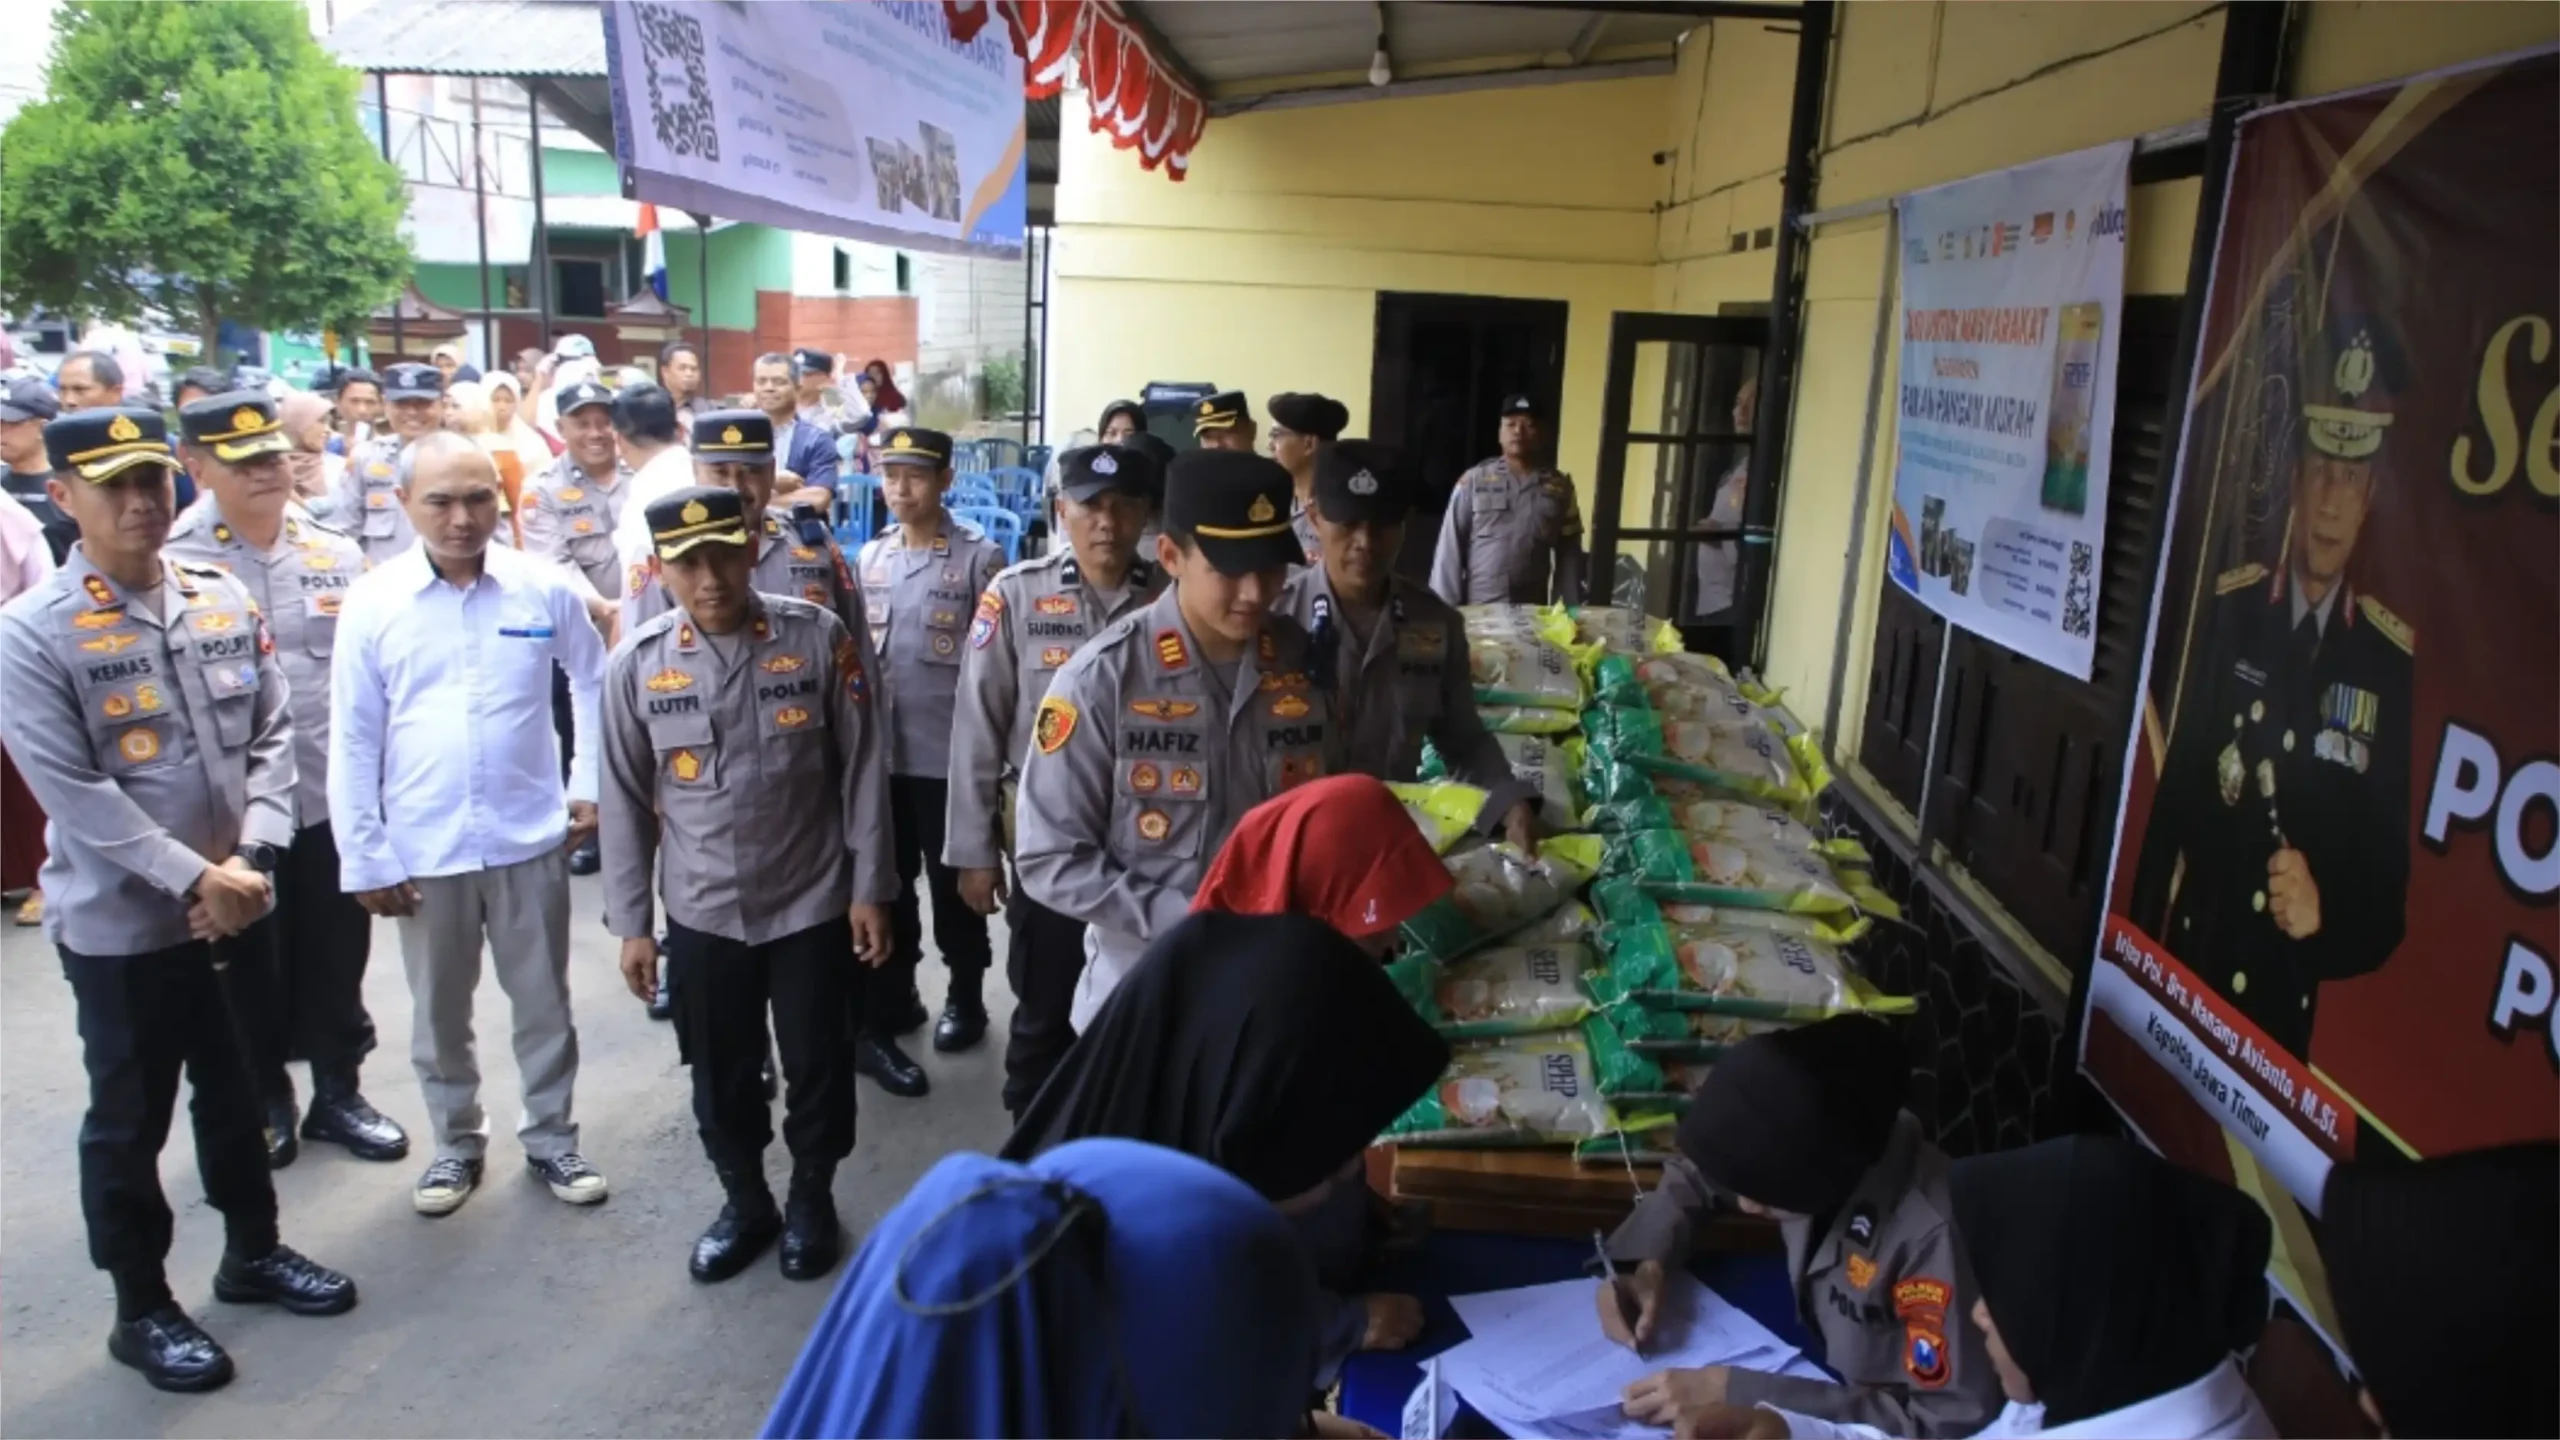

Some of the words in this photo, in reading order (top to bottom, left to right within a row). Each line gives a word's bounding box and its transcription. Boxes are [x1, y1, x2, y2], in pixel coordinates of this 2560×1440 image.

[300, 574, 349, 590] POLRI
[201, 635, 249, 657] POLRI
[87, 657, 153, 684] KEMAS
[759, 679, 819, 701] POLRI
[1127, 730, 1200, 753] HAFIZ
[2493, 940, 2560, 1065] P
[1545, 1054, 1578, 1098] SPHP
[2239, 1035, 2297, 1109] Avianto,
[2193, 1057, 2228, 1103] Jawa
[2229, 1087, 2270, 1141] Timur
